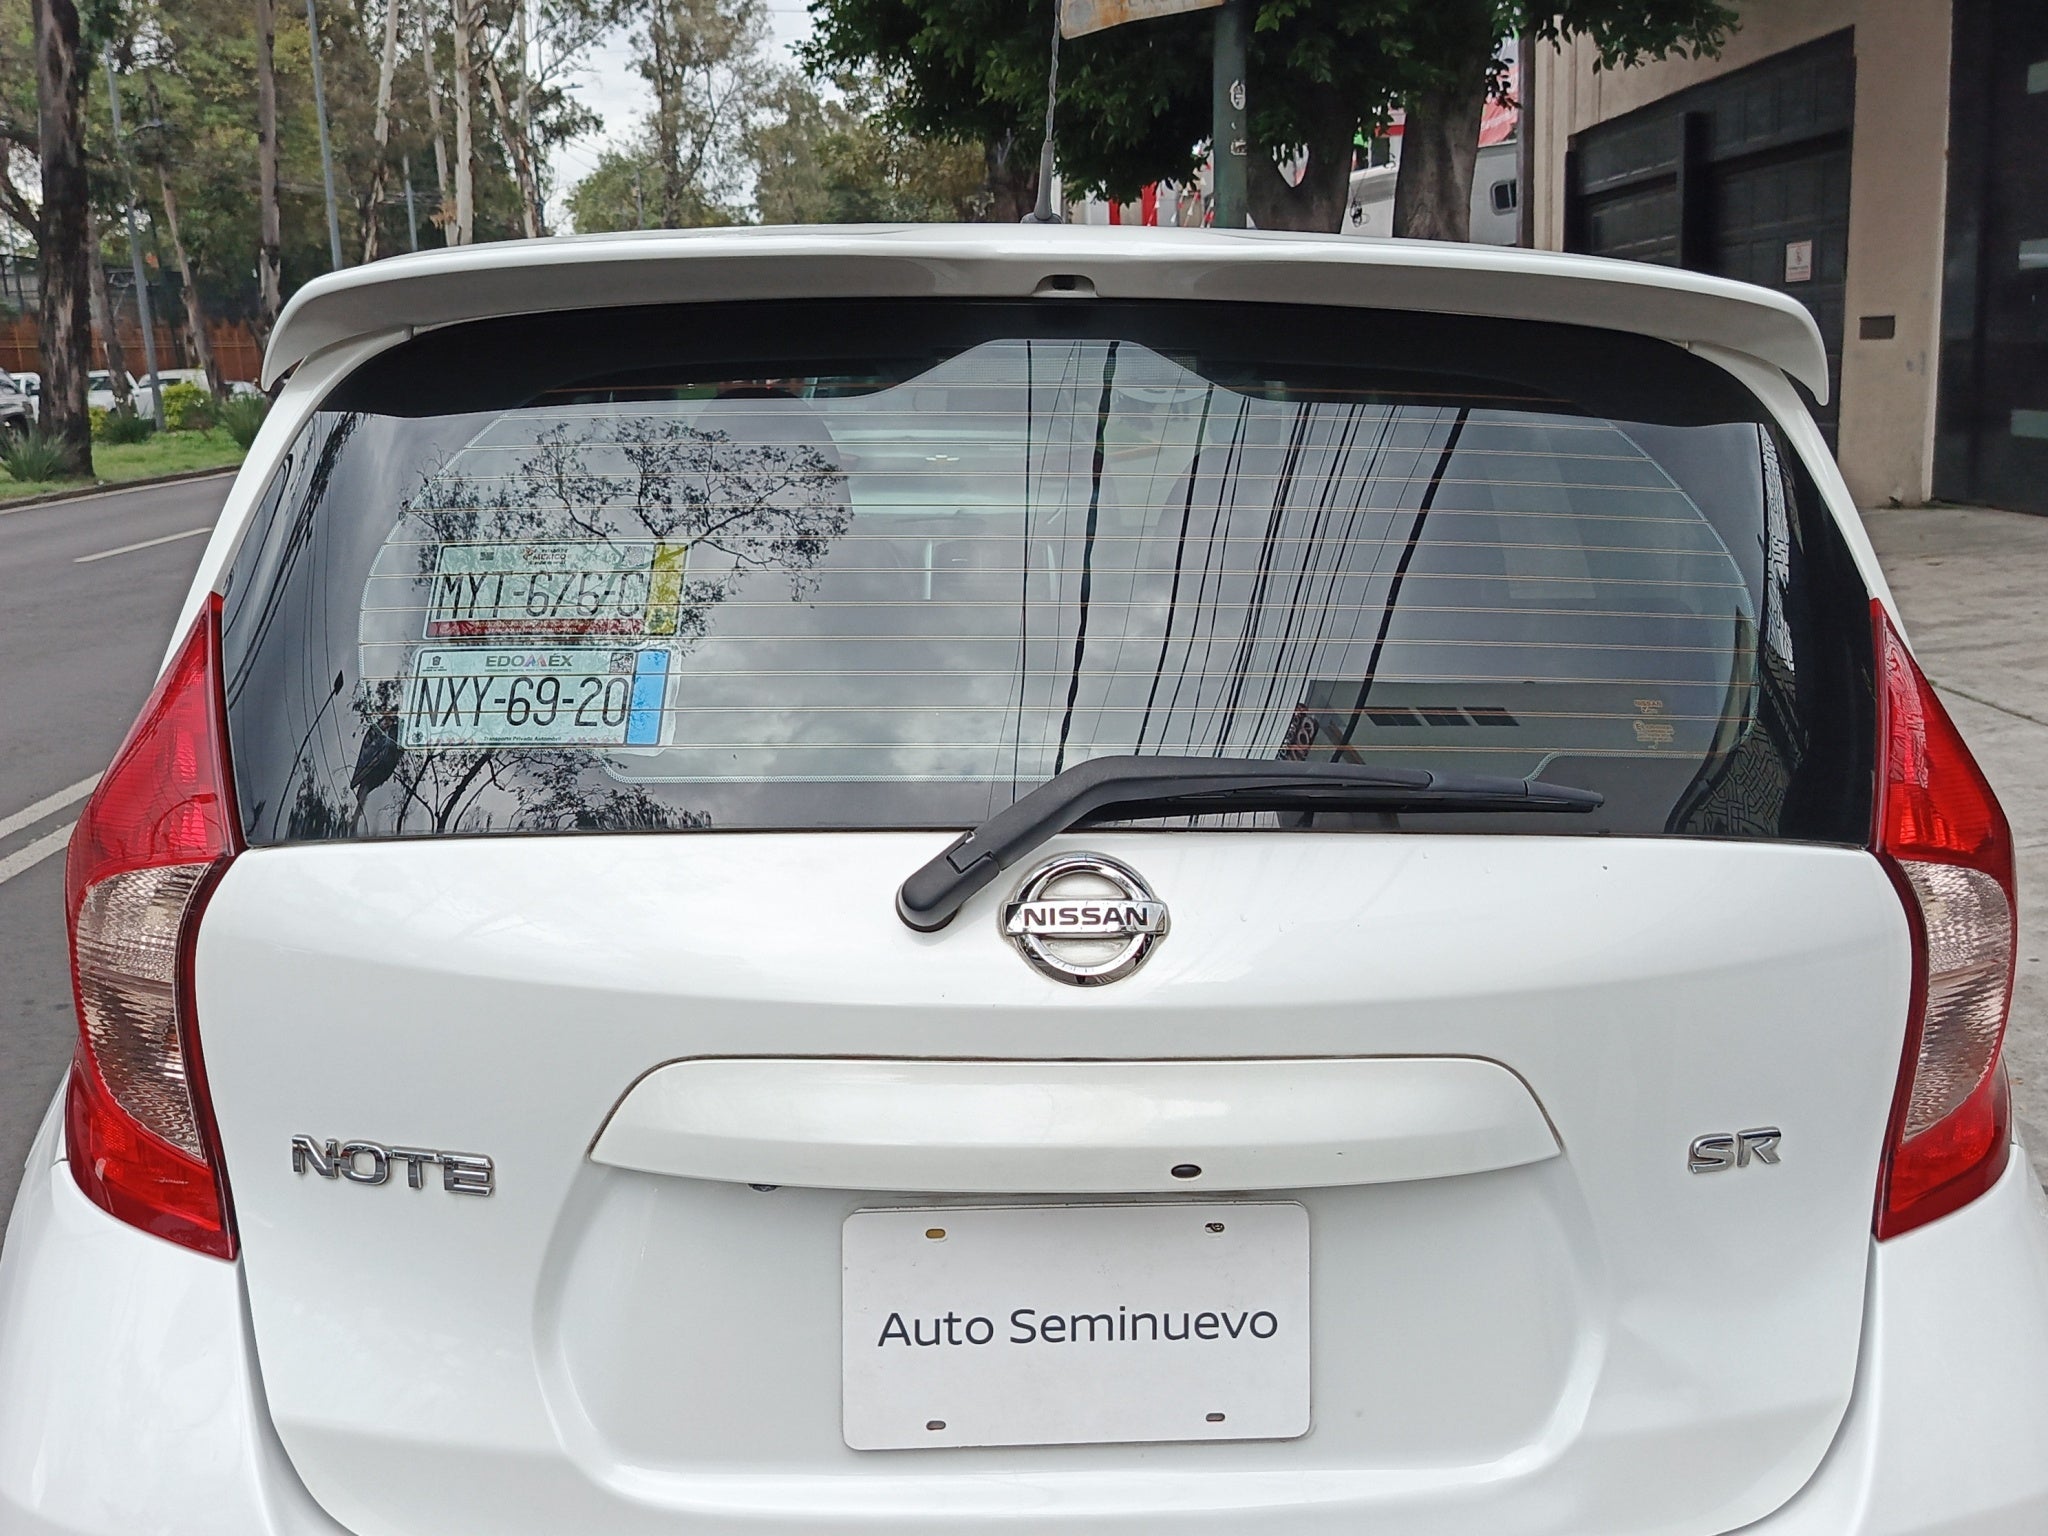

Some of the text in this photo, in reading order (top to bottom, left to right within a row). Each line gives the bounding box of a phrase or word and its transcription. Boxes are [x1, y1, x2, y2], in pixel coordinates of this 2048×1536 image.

[415, 676, 629, 726] NXY-69-20
[1023, 907, 1149, 926] NISSAN
[292, 1134, 494, 1196] NOTE
[1688, 1126, 1781, 1174] SR
[877, 1305, 1278, 1346] Auto Seminuevo
